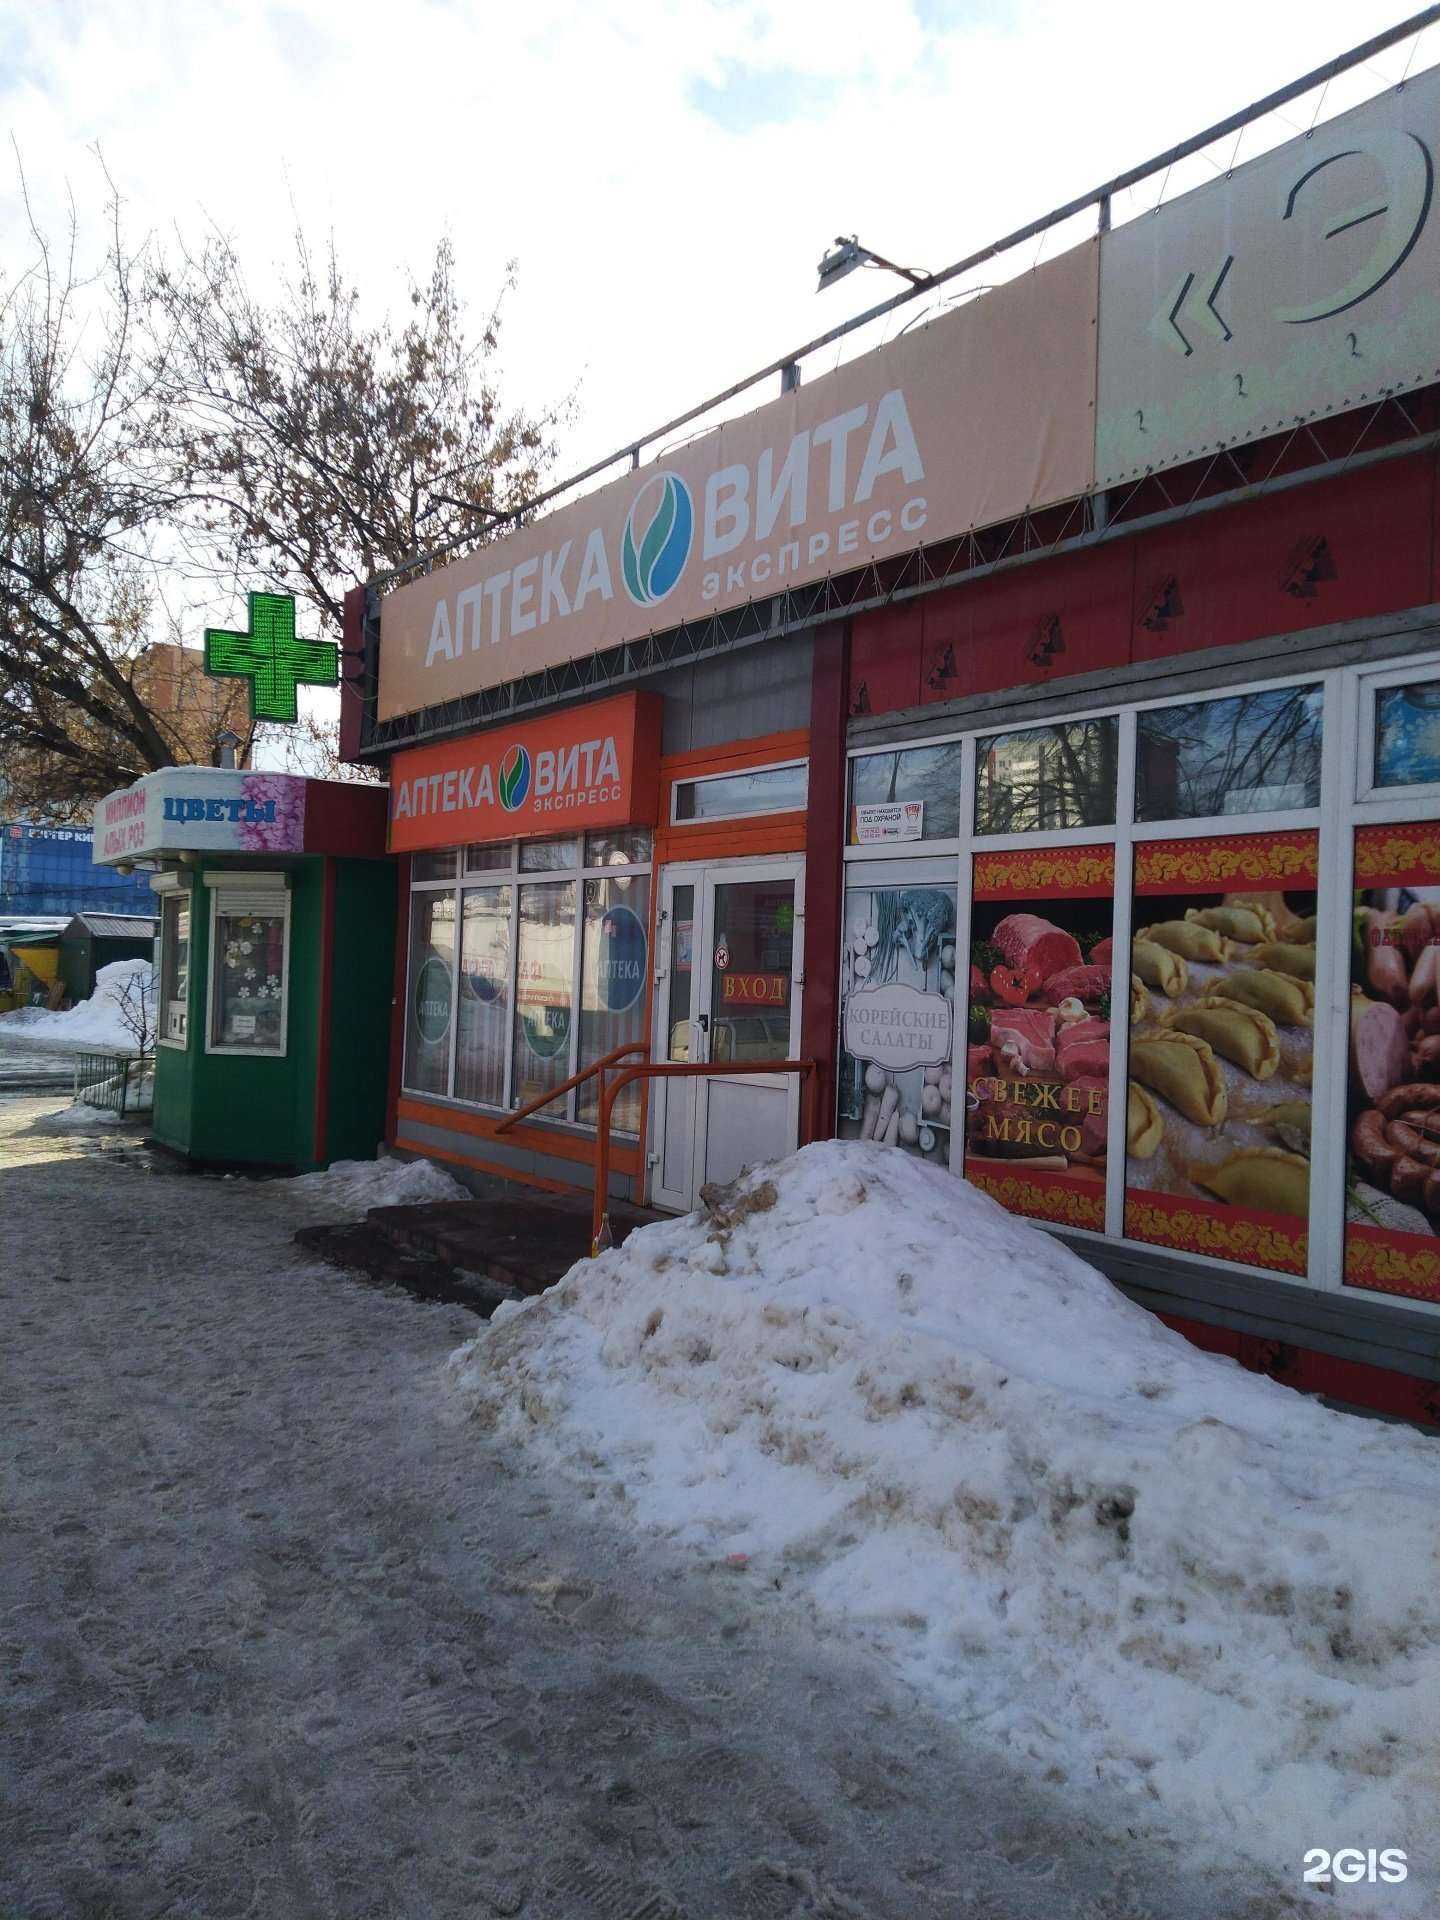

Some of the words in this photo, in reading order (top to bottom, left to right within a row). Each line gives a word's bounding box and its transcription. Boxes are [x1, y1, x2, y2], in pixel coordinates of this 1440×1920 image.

[425, 529, 616, 668] АПТЕКА
[703, 388, 926, 561] ВИТА
[702, 497, 928, 601] ЭКСПРЕСС
[393, 764, 495, 820] АПТЕКА
[535, 736, 621, 796] ВИТА
[163, 798, 276, 824] ЦВЕТЫ
[534, 785, 622, 813] ЭКСПРЕСС
[724, 976, 785, 1000] ВХОД
[848, 1007, 948, 1030] КОРЕЙСКИЕ
[861, 1029, 934, 1050] САЛАТЫ
[969, 1077, 1103, 1116] СВЕЖЕЕ
[987, 1115, 1082, 1152] МЯСО
